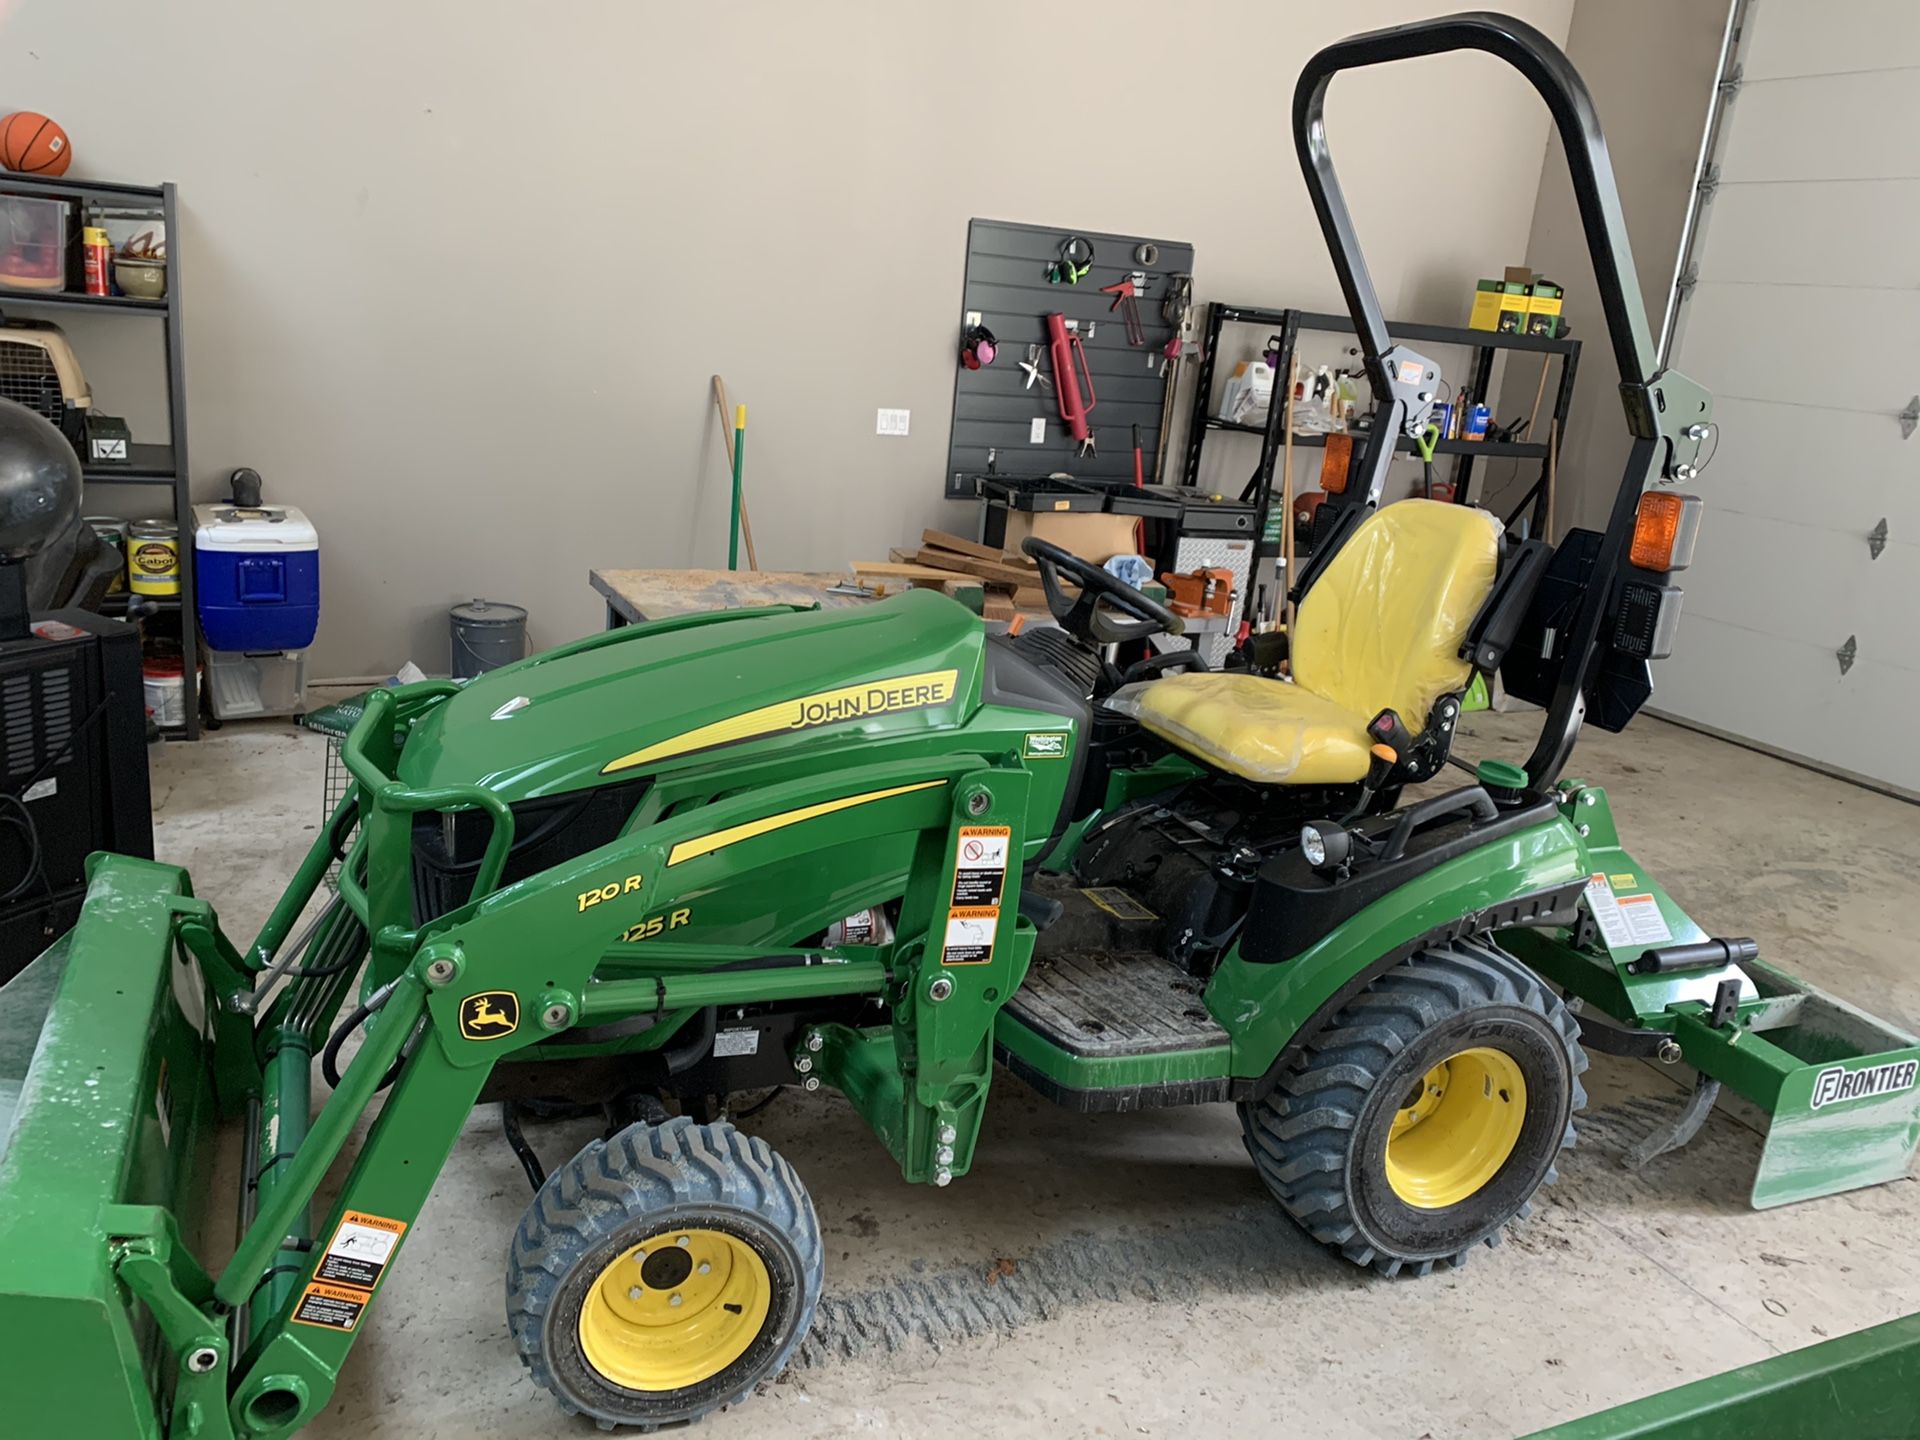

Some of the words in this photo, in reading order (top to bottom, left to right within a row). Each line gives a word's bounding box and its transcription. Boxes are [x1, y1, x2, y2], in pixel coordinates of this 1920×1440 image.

[138, 556, 174, 566] Cabot
[791, 696, 861, 726] JOHN
[867, 683, 944, 710] DEERE
[970, 828, 1008, 836] WARNING
[576, 882, 621, 913] 120
[623, 874, 643, 894] R
[669, 908, 691, 930] R
[958, 910, 997, 918] WARNING
[1812, 1062, 1918, 1108] FRONTIER
[359, 1216, 399, 1231] WARNING
[323, 1287, 363, 1302] WARNING
